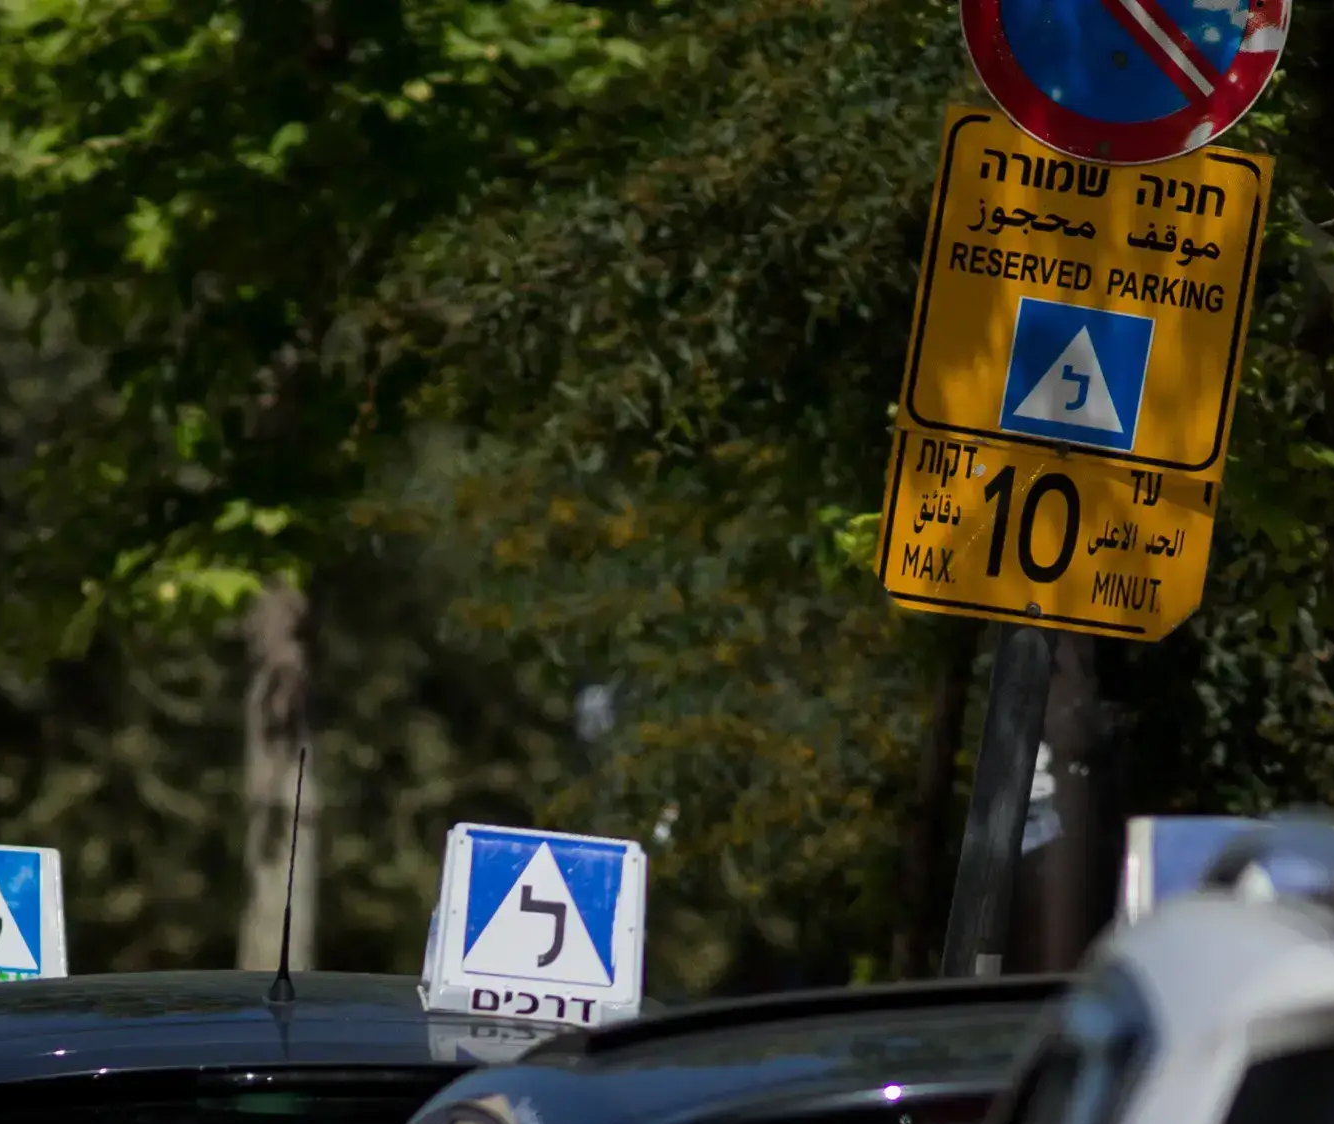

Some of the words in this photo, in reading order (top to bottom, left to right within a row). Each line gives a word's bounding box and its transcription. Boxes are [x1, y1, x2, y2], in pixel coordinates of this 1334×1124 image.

[980, 149, 1110, 197] שמורה
[1136, 174, 1226, 217] חניה
[967, 199, 1096, 239] محجوز
[1127, 222, 1220, 266] موقف
[949, 242, 1092, 291] RESERVED
[1107, 269, 1225, 313] PARKING
[1062, 365, 1089, 410] ל
[916, 439, 978, 487] דקות
[1131, 470, 1163, 506] עד
[984, 465, 1081, 583] 10
[901, 543, 956, 583] MAX.
[520, 885, 566, 967] ל
[472, 988, 596, 1023] דרכים
